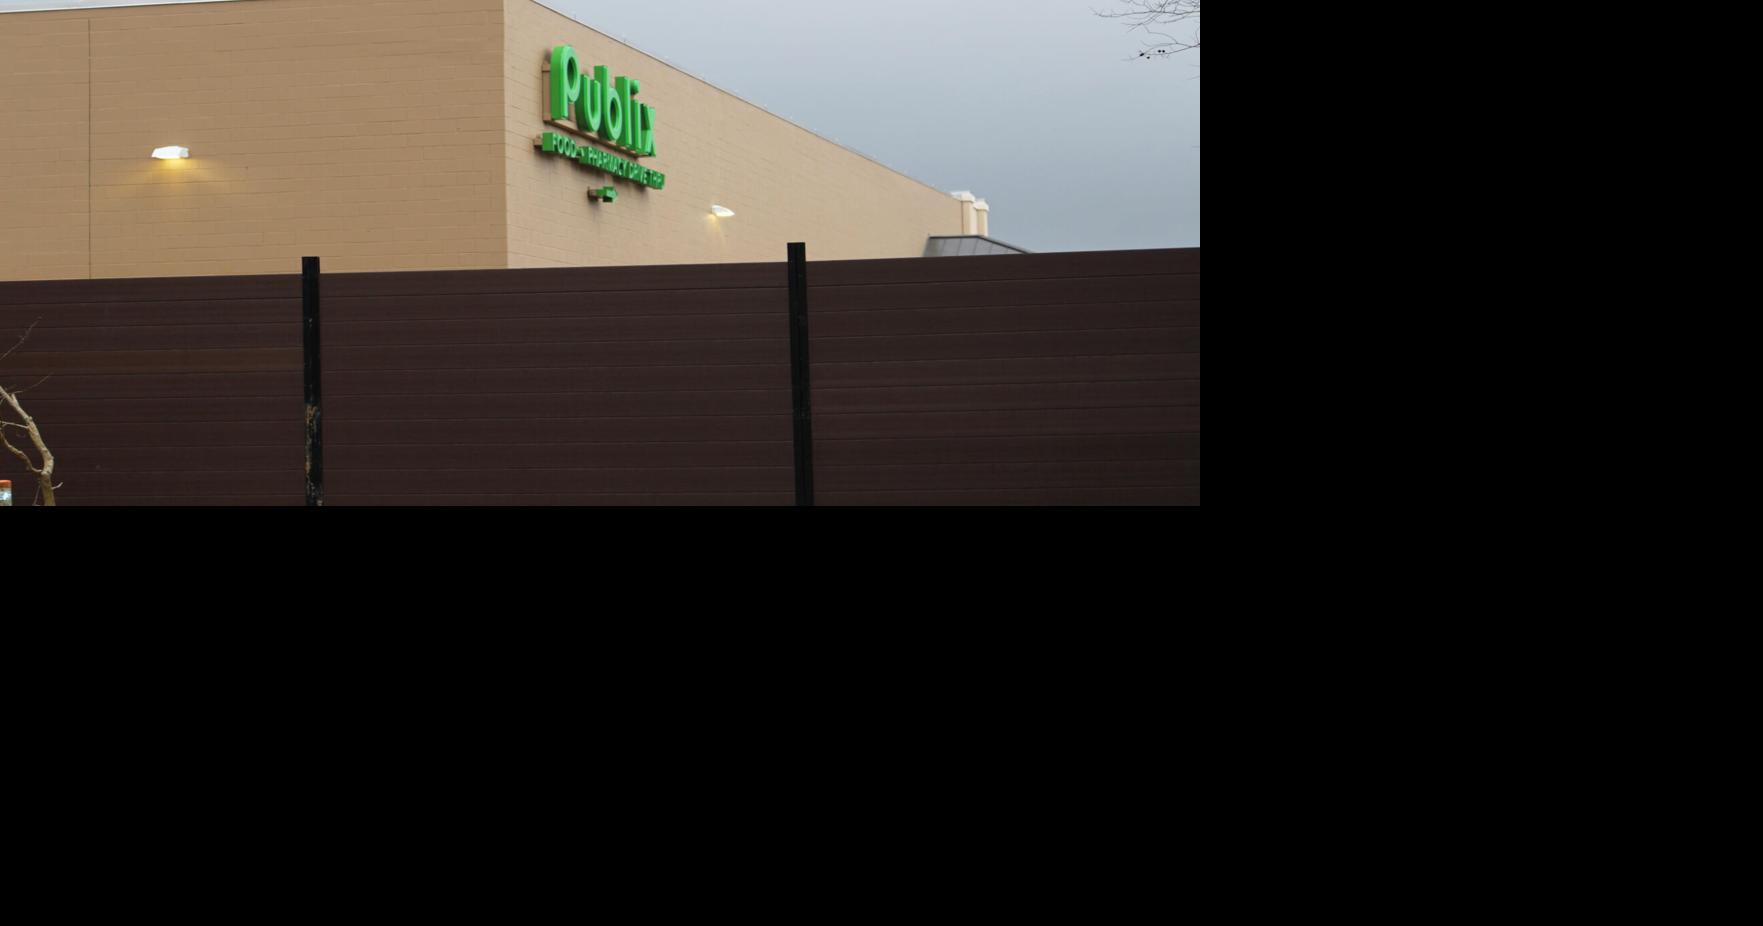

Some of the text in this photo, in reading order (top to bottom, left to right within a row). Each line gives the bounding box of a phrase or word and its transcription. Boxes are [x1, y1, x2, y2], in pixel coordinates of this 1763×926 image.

[550, 44, 657, 157] Publix
[545, 131, 578, 159] FOOD
[586, 146, 628, 177] PHARMACY
